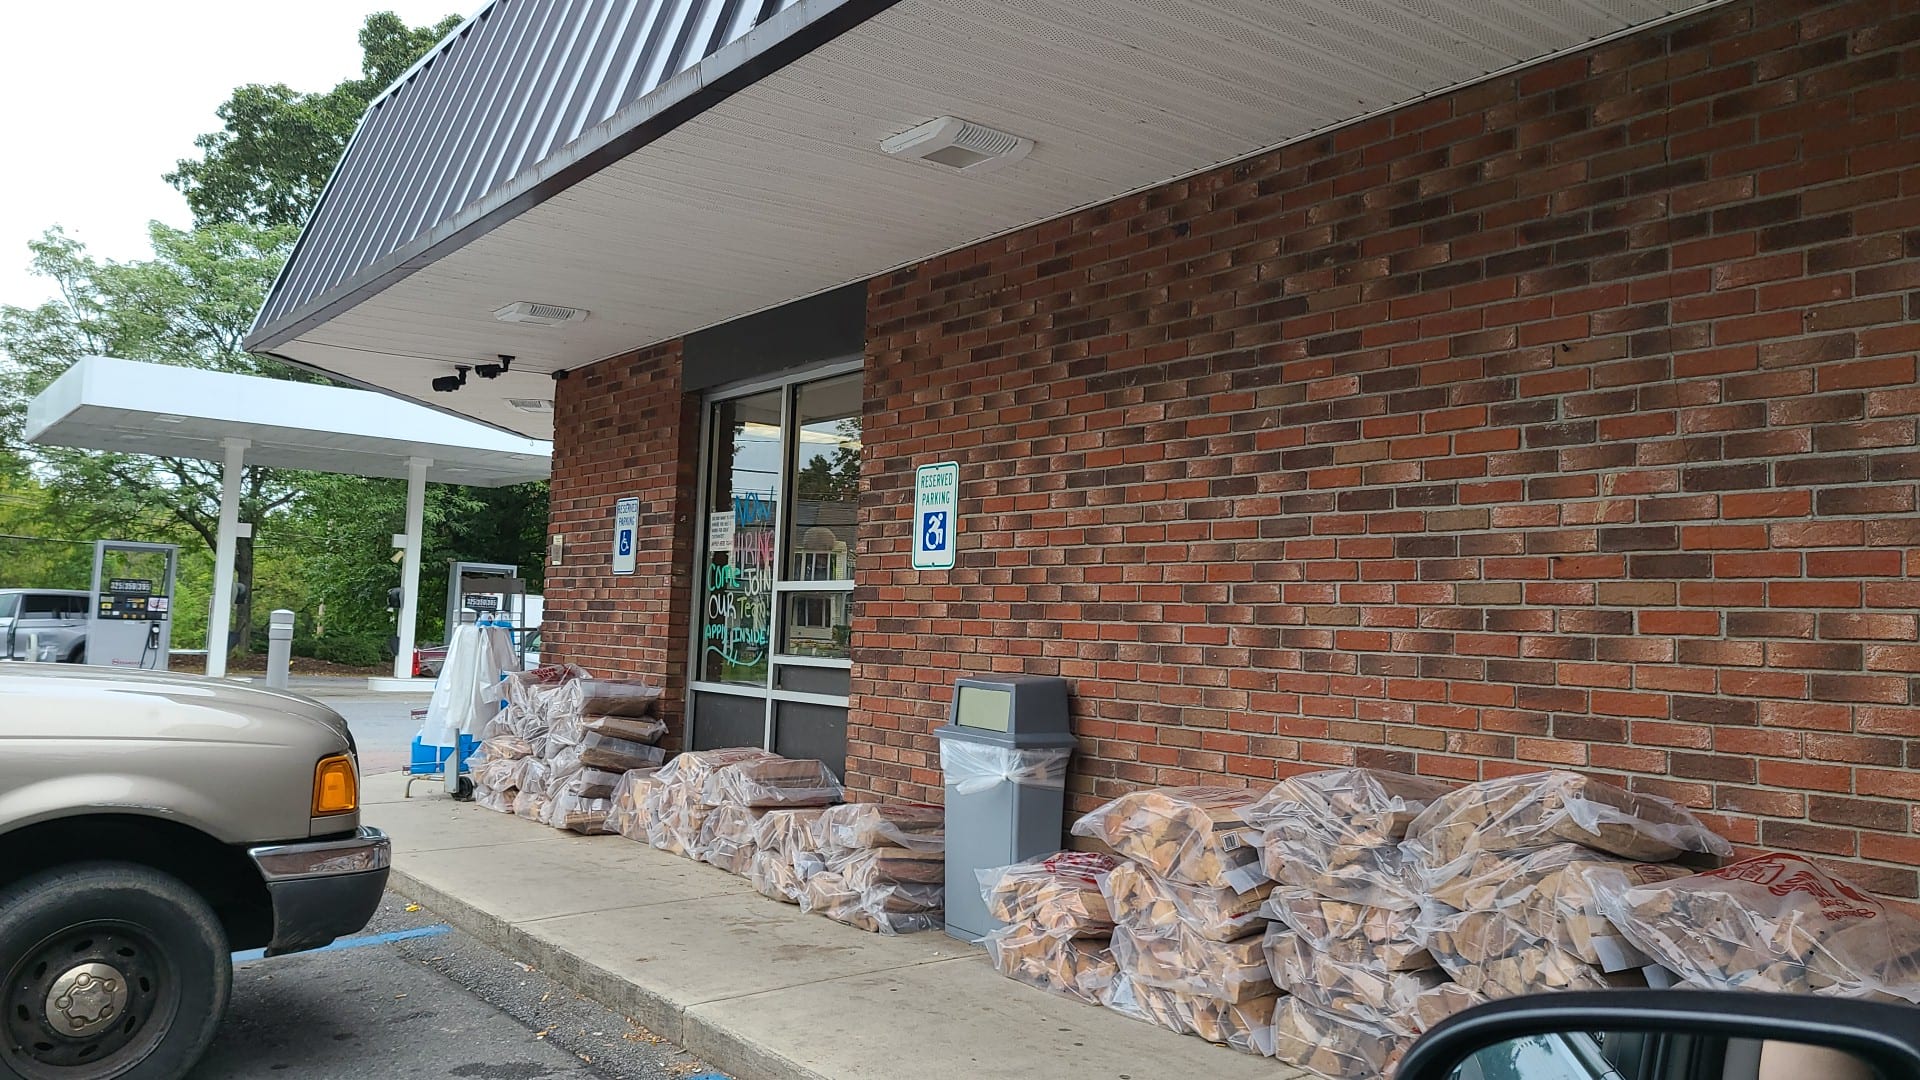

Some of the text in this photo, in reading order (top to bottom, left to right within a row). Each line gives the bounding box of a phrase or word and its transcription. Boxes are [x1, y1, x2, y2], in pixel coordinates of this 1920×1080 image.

[921, 472, 953, 488] RESERVED
[922, 490, 950, 506] PARKING
[619, 516, 635, 526] PARKING
[733, 529, 775, 566] HIRING
[709, 592, 737, 619] OUR
